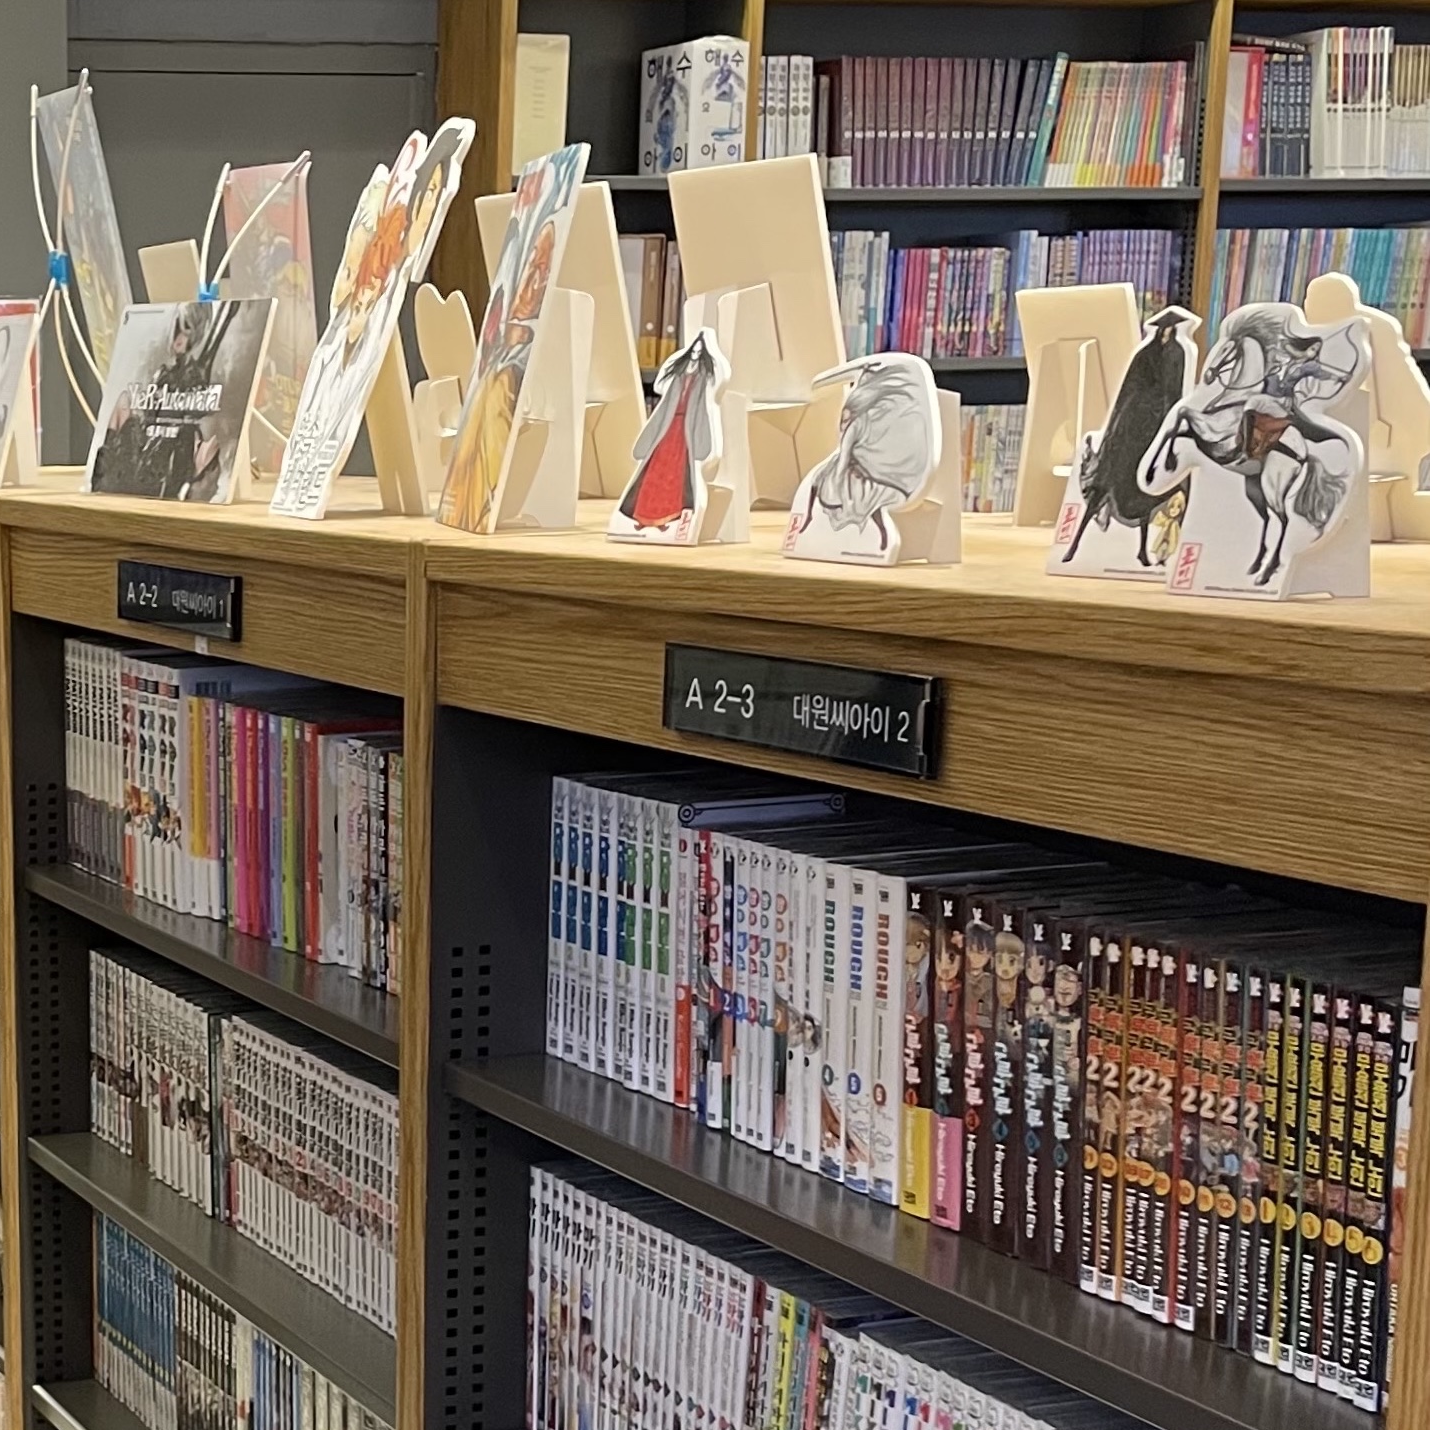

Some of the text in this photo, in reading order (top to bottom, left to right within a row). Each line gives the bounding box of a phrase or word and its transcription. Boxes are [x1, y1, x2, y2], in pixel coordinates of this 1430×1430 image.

[127, 582, 223, 619] A 2-2 대원씨아이 1
[685, 677, 909, 743] A 2-3 대원씨아이 2
[824, 900, 835, 983] ROUGH
[850, 906, 862, 990] ROUGH
[876, 913, 889, 1001] ROUGH
[935, 1123, 948, 1200] Hiroyuki Eto
[964, 1134, 978, 1213] Hiroyuki Eto
[992, 1144, 1006, 1224] Hiroyuki Eto
[1024, 1157, 1037, 1238] Hiroyuki Eto
[1053, 1170, 1065, 1252] Hiroyuki Eto
